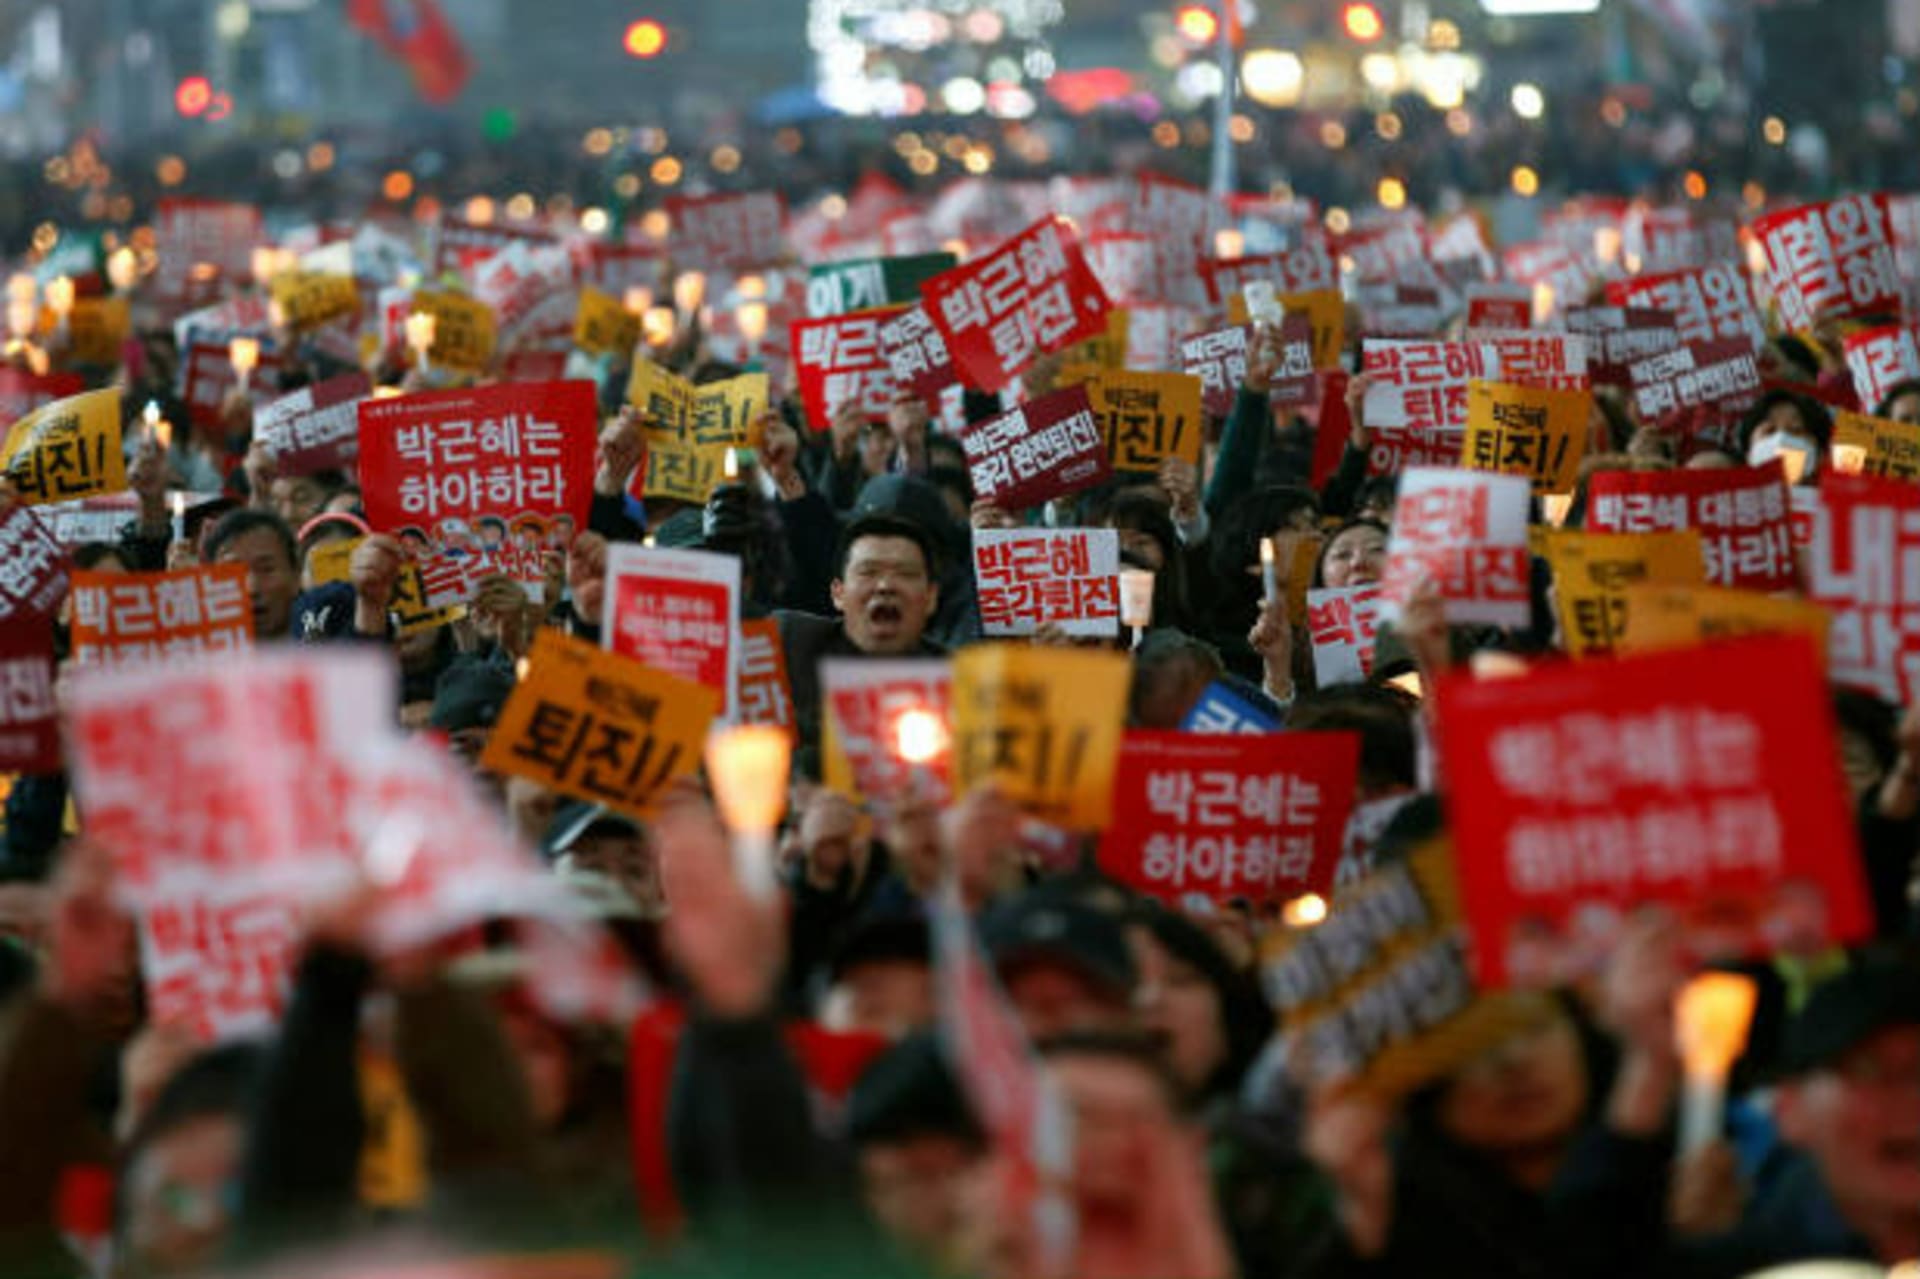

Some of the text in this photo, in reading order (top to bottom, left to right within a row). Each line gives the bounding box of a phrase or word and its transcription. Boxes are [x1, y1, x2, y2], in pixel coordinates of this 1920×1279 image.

[940, 227, 1064, 332] 박근혜
[1364, 339, 1485, 385] 박근혜
[1495, 338, 1567, 374] 근혜
[396, 413, 563, 464] 박근혜는
[961, 409, 1028, 456] 박근혜
[398, 464, 566, 517] 하야하라
[977, 533, 1089, 584] 박근혜
[74, 575, 244, 635] 박근혜는
[978, 575, 1119, 627] 즉각퇴진
[511, 698, 683, 806] 퇴진!
[1147, 771, 1320, 826] 박근혜는
[1142, 831, 1315, 888] 하야하라
